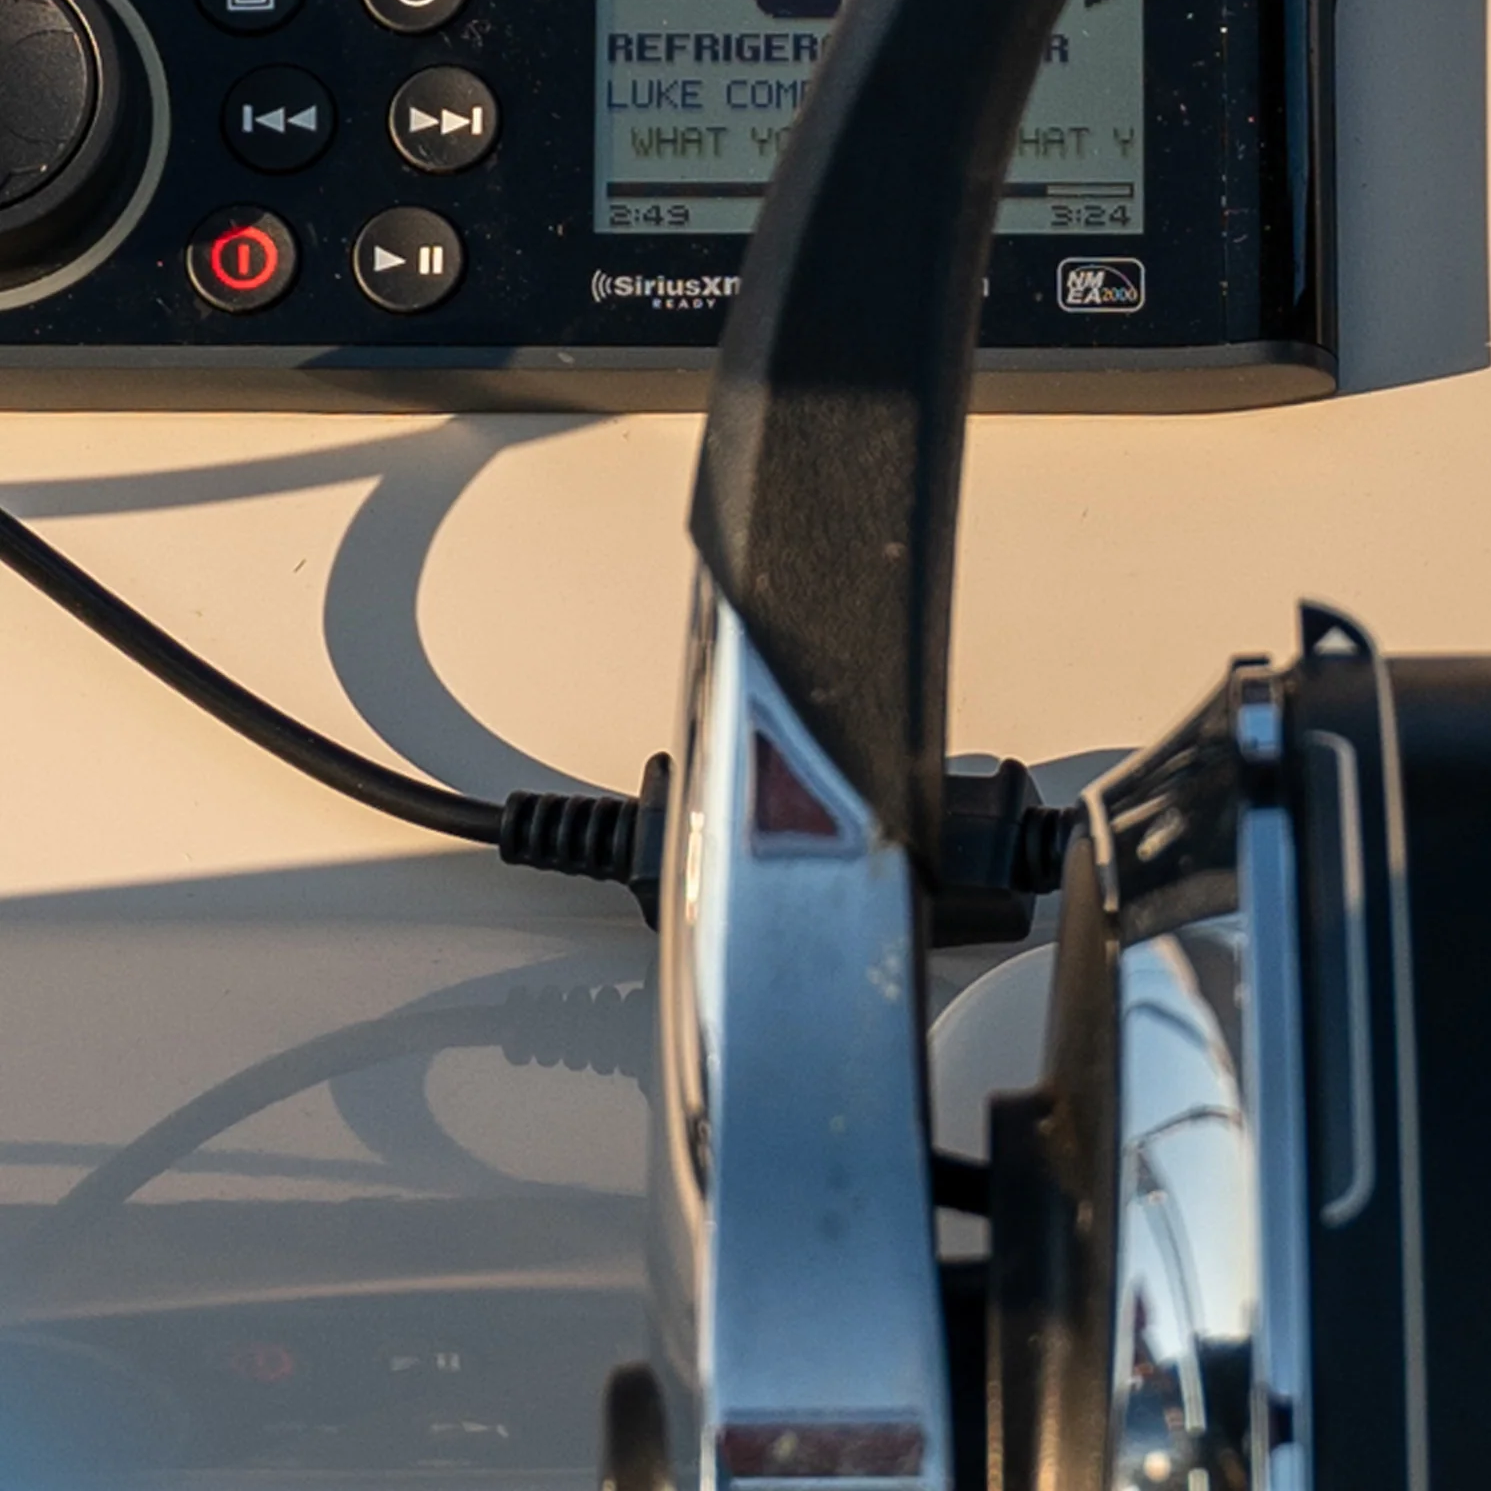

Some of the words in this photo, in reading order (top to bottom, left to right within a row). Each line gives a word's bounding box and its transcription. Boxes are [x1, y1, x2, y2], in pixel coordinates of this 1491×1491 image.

[606, 79, 703, 109] LUKE
[630, 126, 725, 159] WHAT
[1018, 126, 1089, 158] HAT
[608, 206, 690, 228] 2:49
[1050, 206, 1132, 228] 3:24
[652, 298, 717, 310] READY
